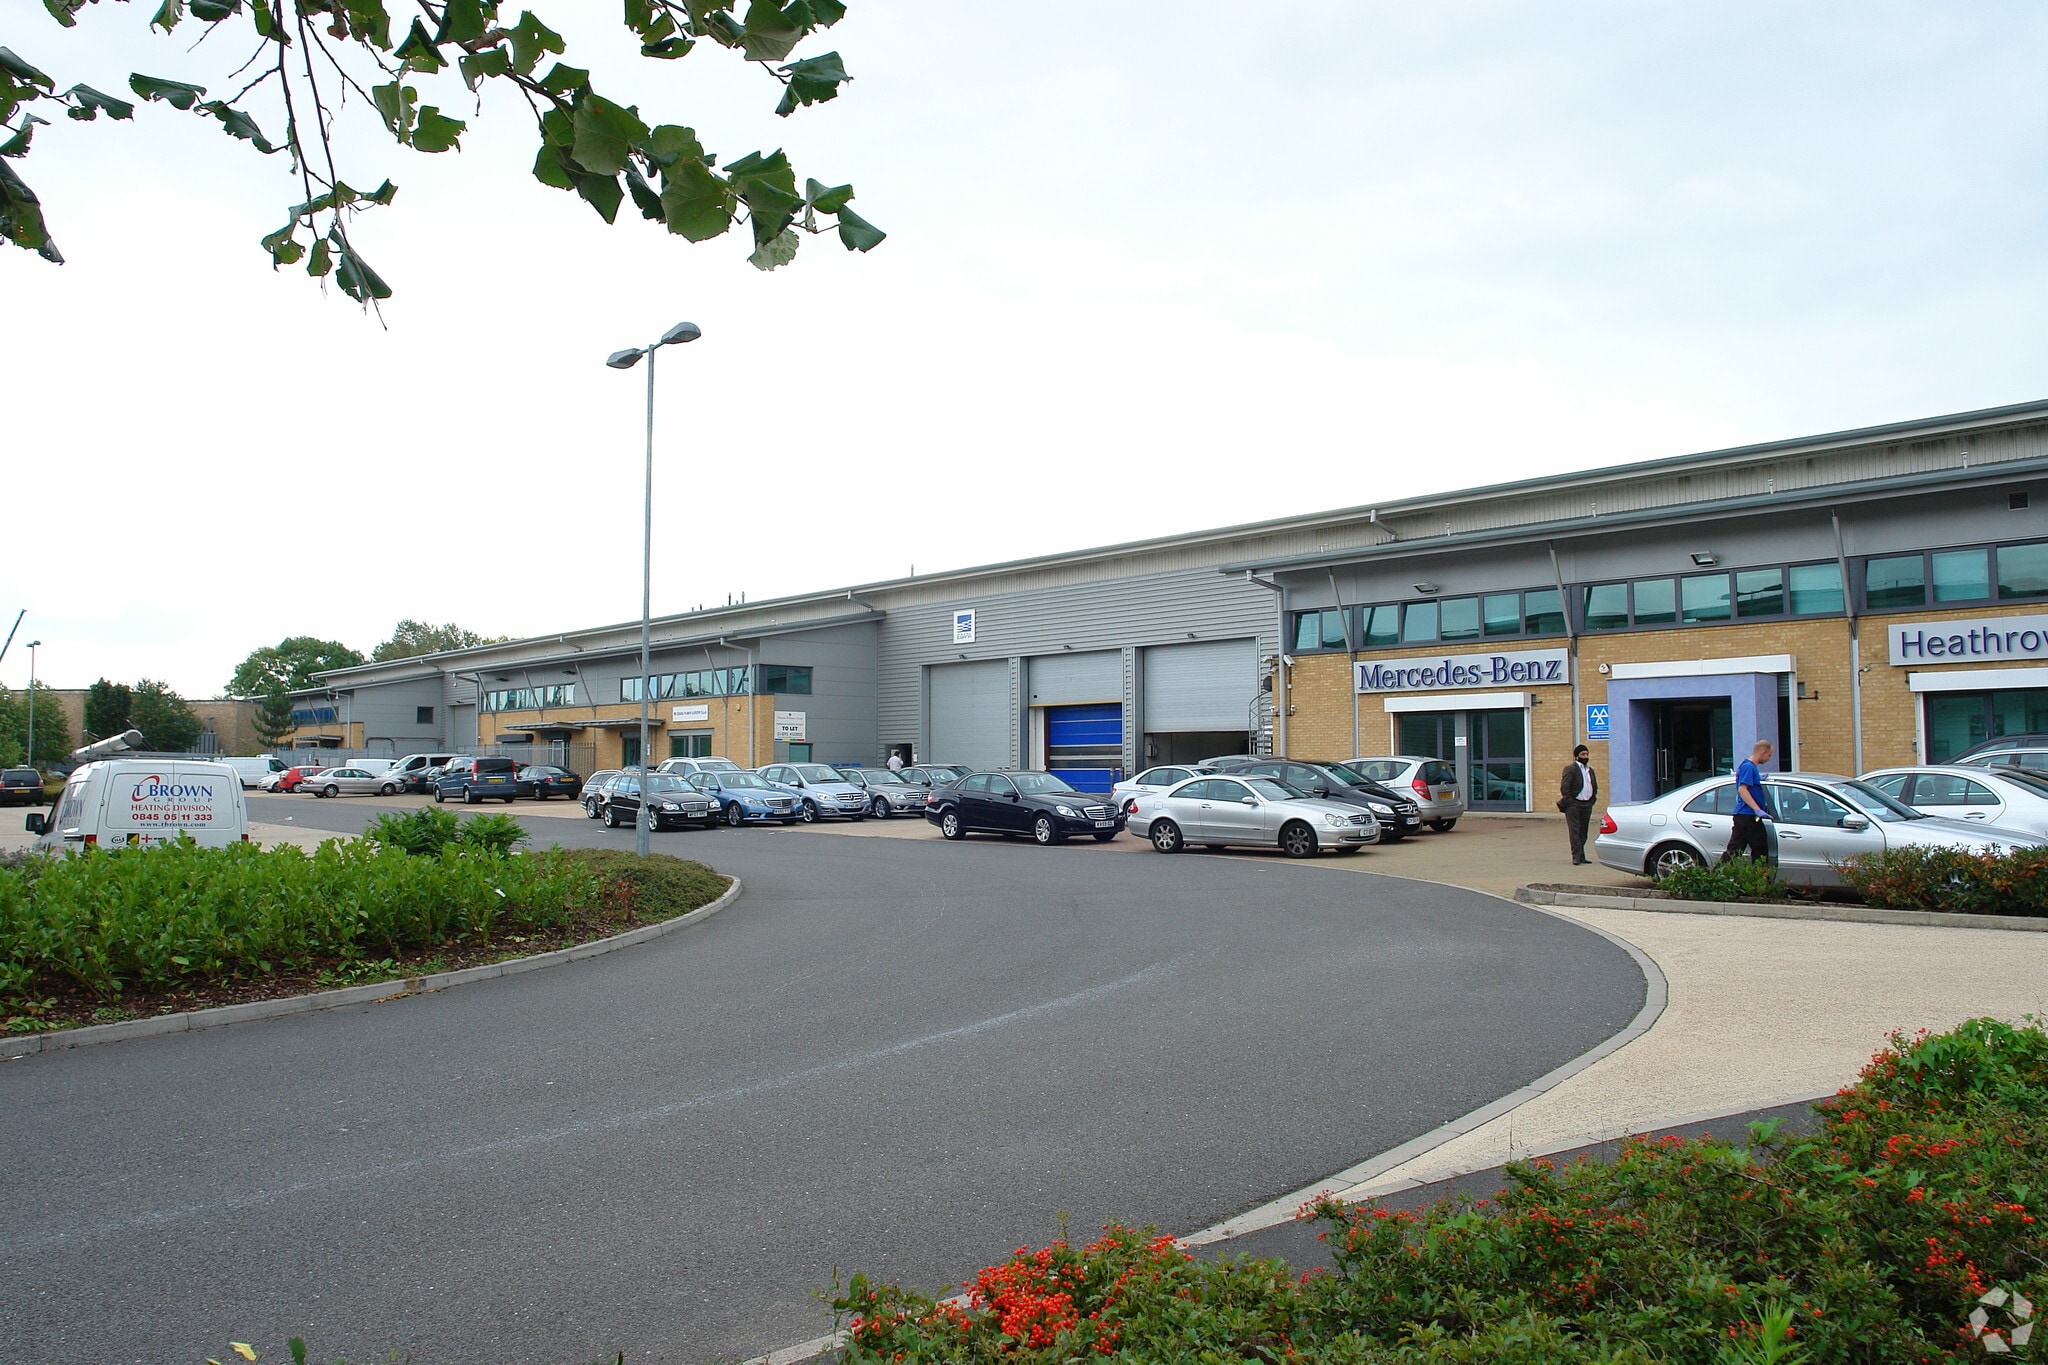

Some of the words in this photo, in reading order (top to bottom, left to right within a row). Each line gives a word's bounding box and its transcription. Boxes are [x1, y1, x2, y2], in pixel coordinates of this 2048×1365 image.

[1901, 626, 2048, 657] Heathro
[1358, 656, 1562, 690] Mercedes-Benz
[149, 785, 213, 797] BROWN
[131, 804, 171, 812] HEATING
[173, 804, 212, 812] DIVISION
[132, 813, 160, 821] 0845
[163, 813, 177, 821] 05
[194, 813, 213, 821] 333
